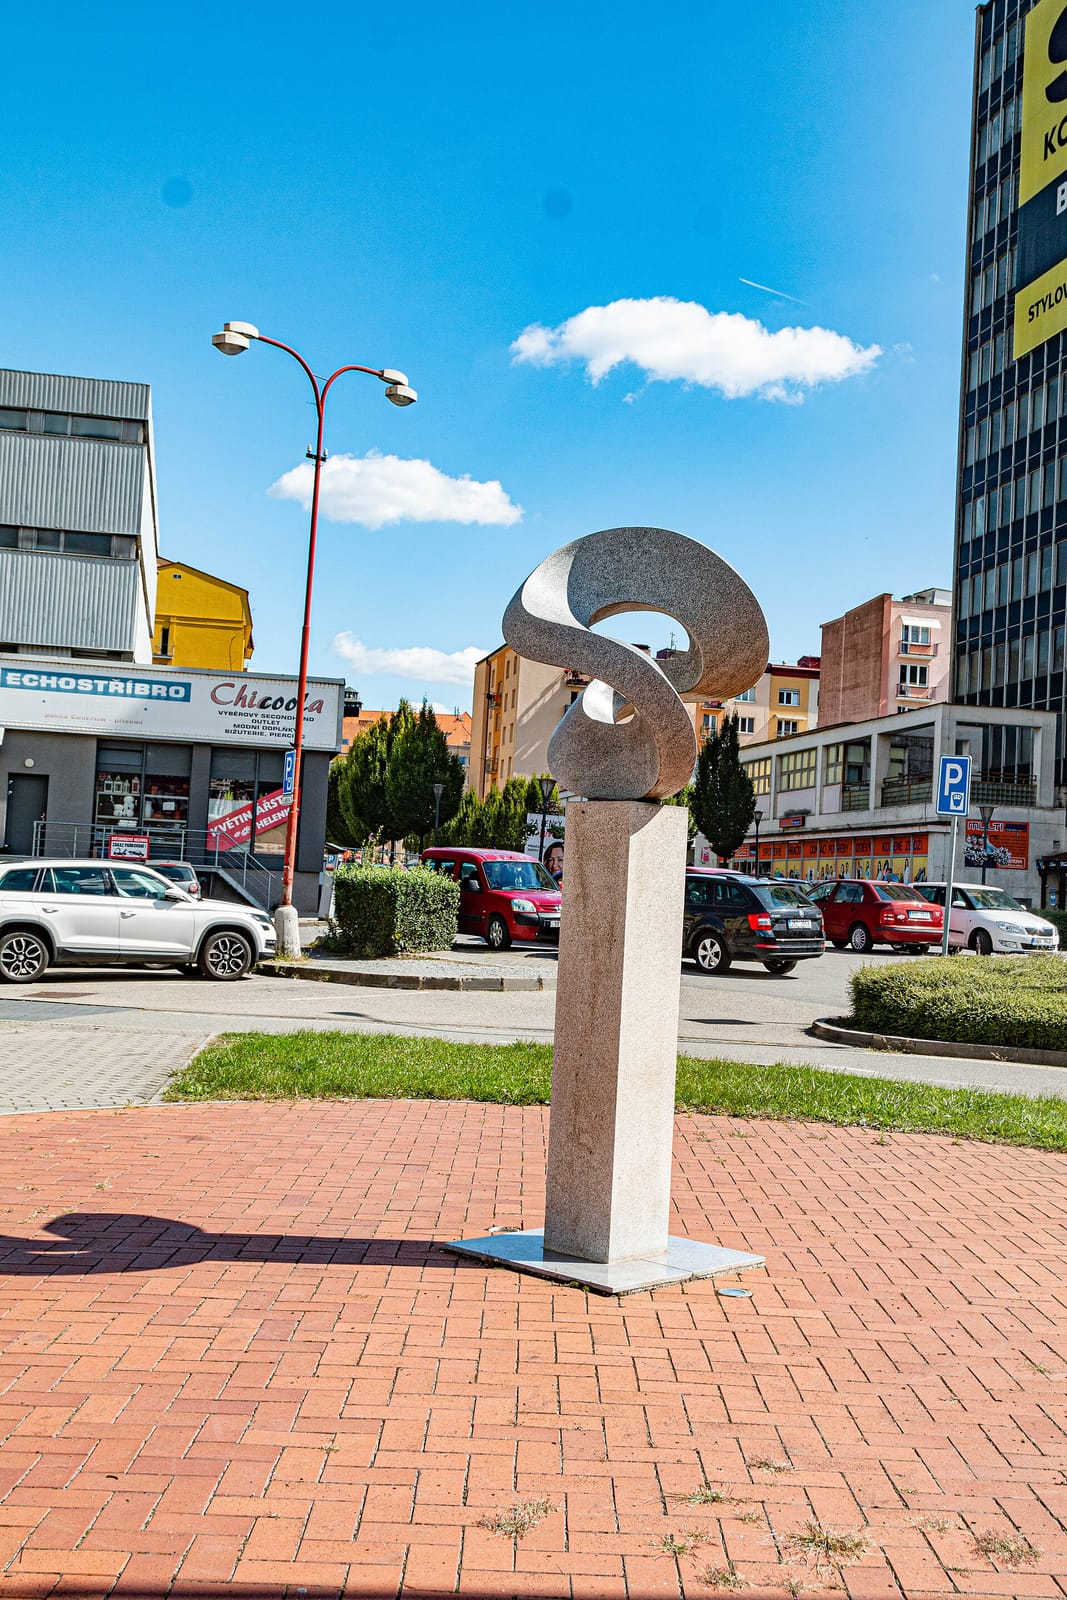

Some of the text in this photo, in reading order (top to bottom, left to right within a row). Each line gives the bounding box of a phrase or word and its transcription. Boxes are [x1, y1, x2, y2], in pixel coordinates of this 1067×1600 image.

[6, 672, 186, 699] ECHOSTŘÍBRO
[251, 718, 281, 726] OUTLET
[261, 713, 315, 722] SECONDHND
[945, 763, 963, 796] P
[255, 807, 291, 830] HELENK
